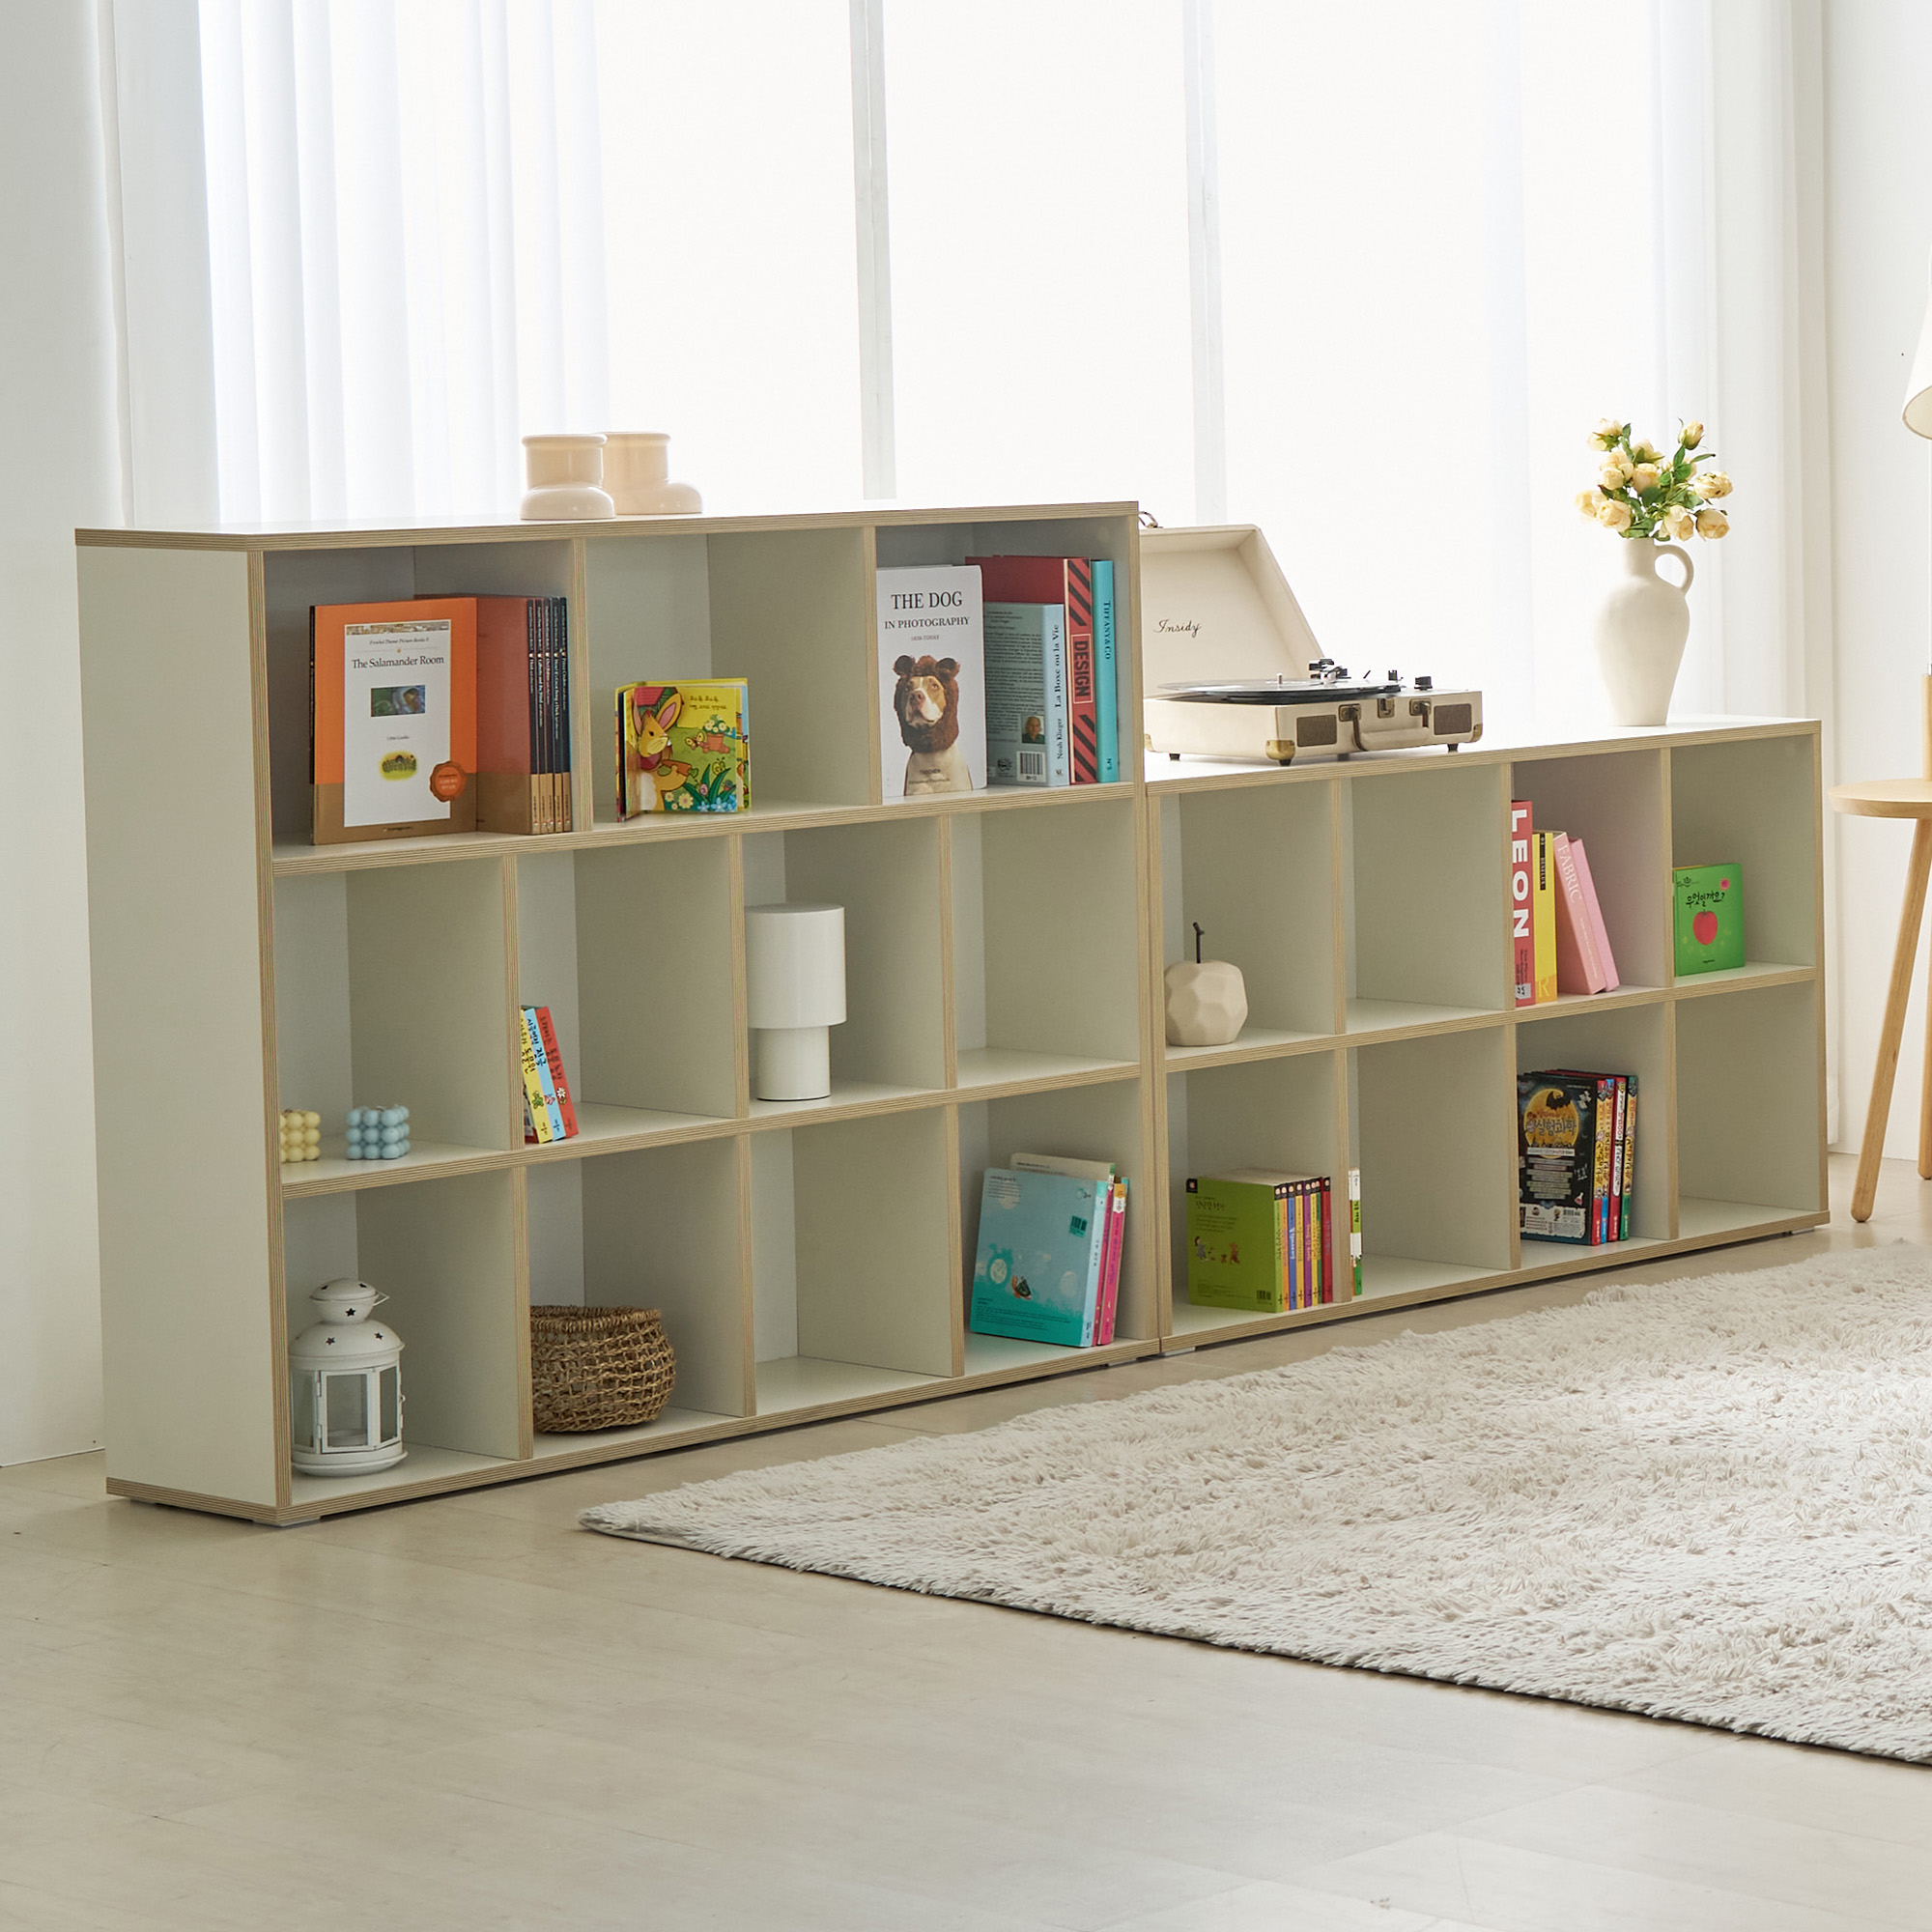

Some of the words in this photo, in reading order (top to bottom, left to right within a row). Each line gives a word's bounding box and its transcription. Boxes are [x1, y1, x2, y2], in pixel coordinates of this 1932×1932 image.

[891, 593, 924, 610] THE
[928, 591, 963, 609] DOG
[884, 620, 895, 630] IN
[897, 616, 970, 629] PHOTOGRAPHY
[1152, 619, 1202, 639] Insidy
[352, 659, 368, 668] The
[369, 656, 418, 668] Salamander
[419, 655, 444, 666] Room
[1055, 654, 1060, 667] ou
[1074, 640, 1091, 697] DESIGN
[1054, 695, 1062, 708] La
[1511, 809, 1530, 938] LEON
[1557, 844, 1583, 904] FABRIC
